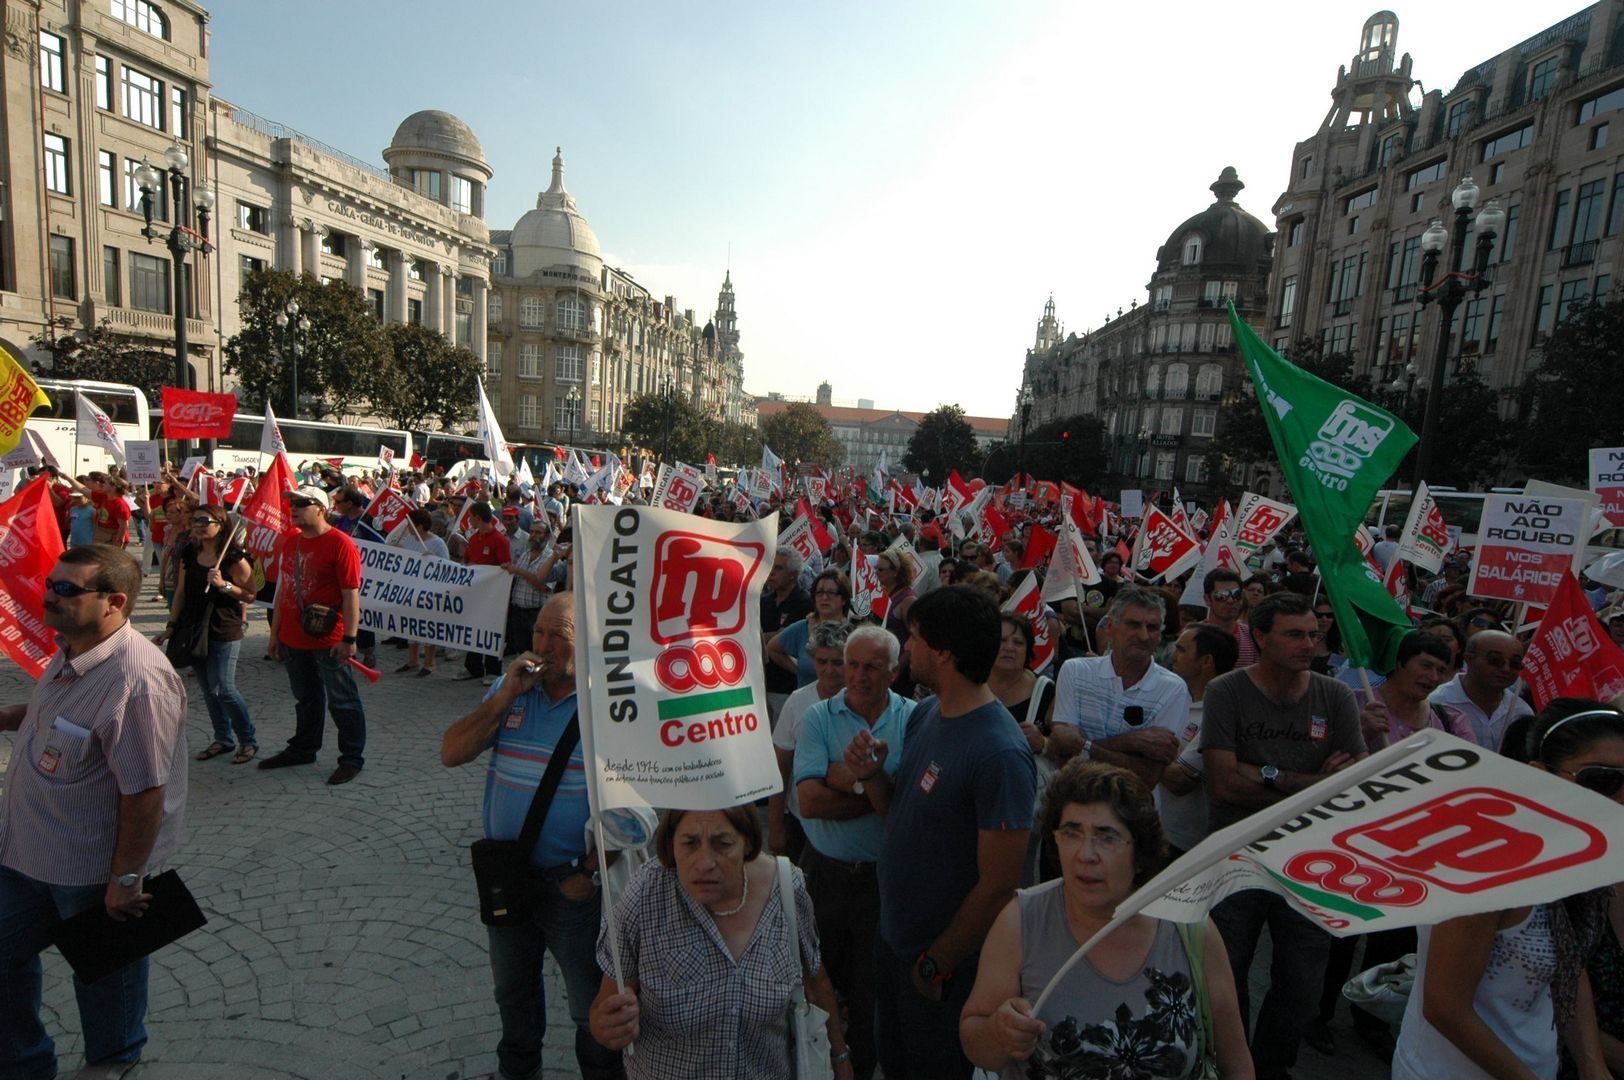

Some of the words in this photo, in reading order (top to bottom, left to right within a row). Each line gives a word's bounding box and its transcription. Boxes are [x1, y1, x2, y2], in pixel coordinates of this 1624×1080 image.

[326, 202, 356, 220] CAIXA
[360, 213, 385, 230] GERAL
[387, 224, 398, 235] DE
[543, 270, 577, 281] MONTEPIO
[1504, 500, 1563, 516] NÃO
[1511, 516, 1551, 529] AO
[1487, 528, 1575, 546] ROUBO
[360, 546, 403, 573] DORES
[403, 557, 422, 577] DA
[1505, 551, 1543, 565] NOS
[1478, 564, 1563, 587] SALÁRIOS
[374, 579, 415, 608] TÁBUA
[416, 590, 464, 615] ESTÃO
[602, 508, 640, 723] SINDICATO
[1, 624, 22, 642] DO
[387, 614, 396, 632] A
[401, 616, 473, 646] PRESENTE
[476, 628, 502, 652] LUT
[660, 711, 758, 747] Centro
[604, 758, 634, 772] desde
[636, 761, 660, 773] 1976
